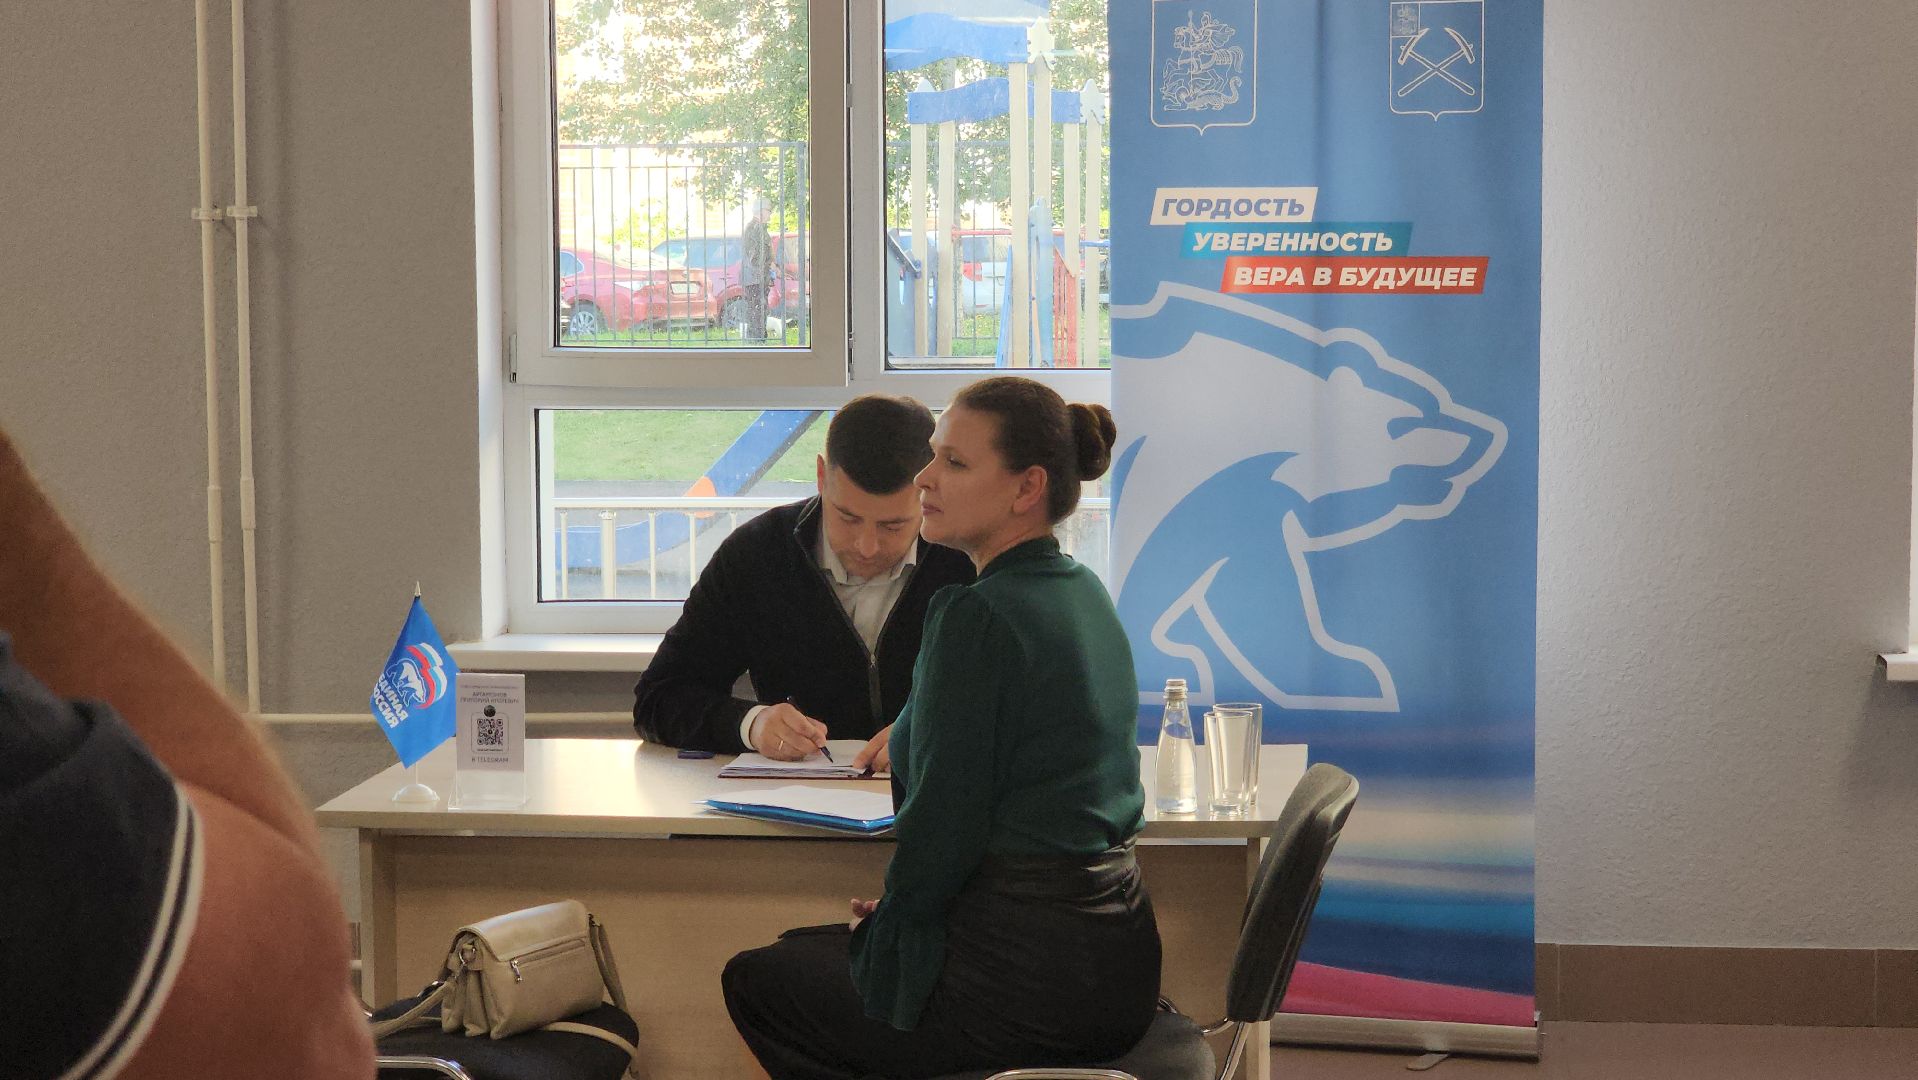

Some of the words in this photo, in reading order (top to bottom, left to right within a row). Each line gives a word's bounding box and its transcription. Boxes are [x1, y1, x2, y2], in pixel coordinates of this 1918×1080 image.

[1161, 198, 1305, 220] ГОРДОСТЬ
[1192, 232, 1393, 252] УВЕРЕННОСТЬ
[1233, 267, 1305, 286] ВЕРА
[1312, 267, 1333, 286] В
[1338, 267, 1478, 290] БУДУЩЕЕ
